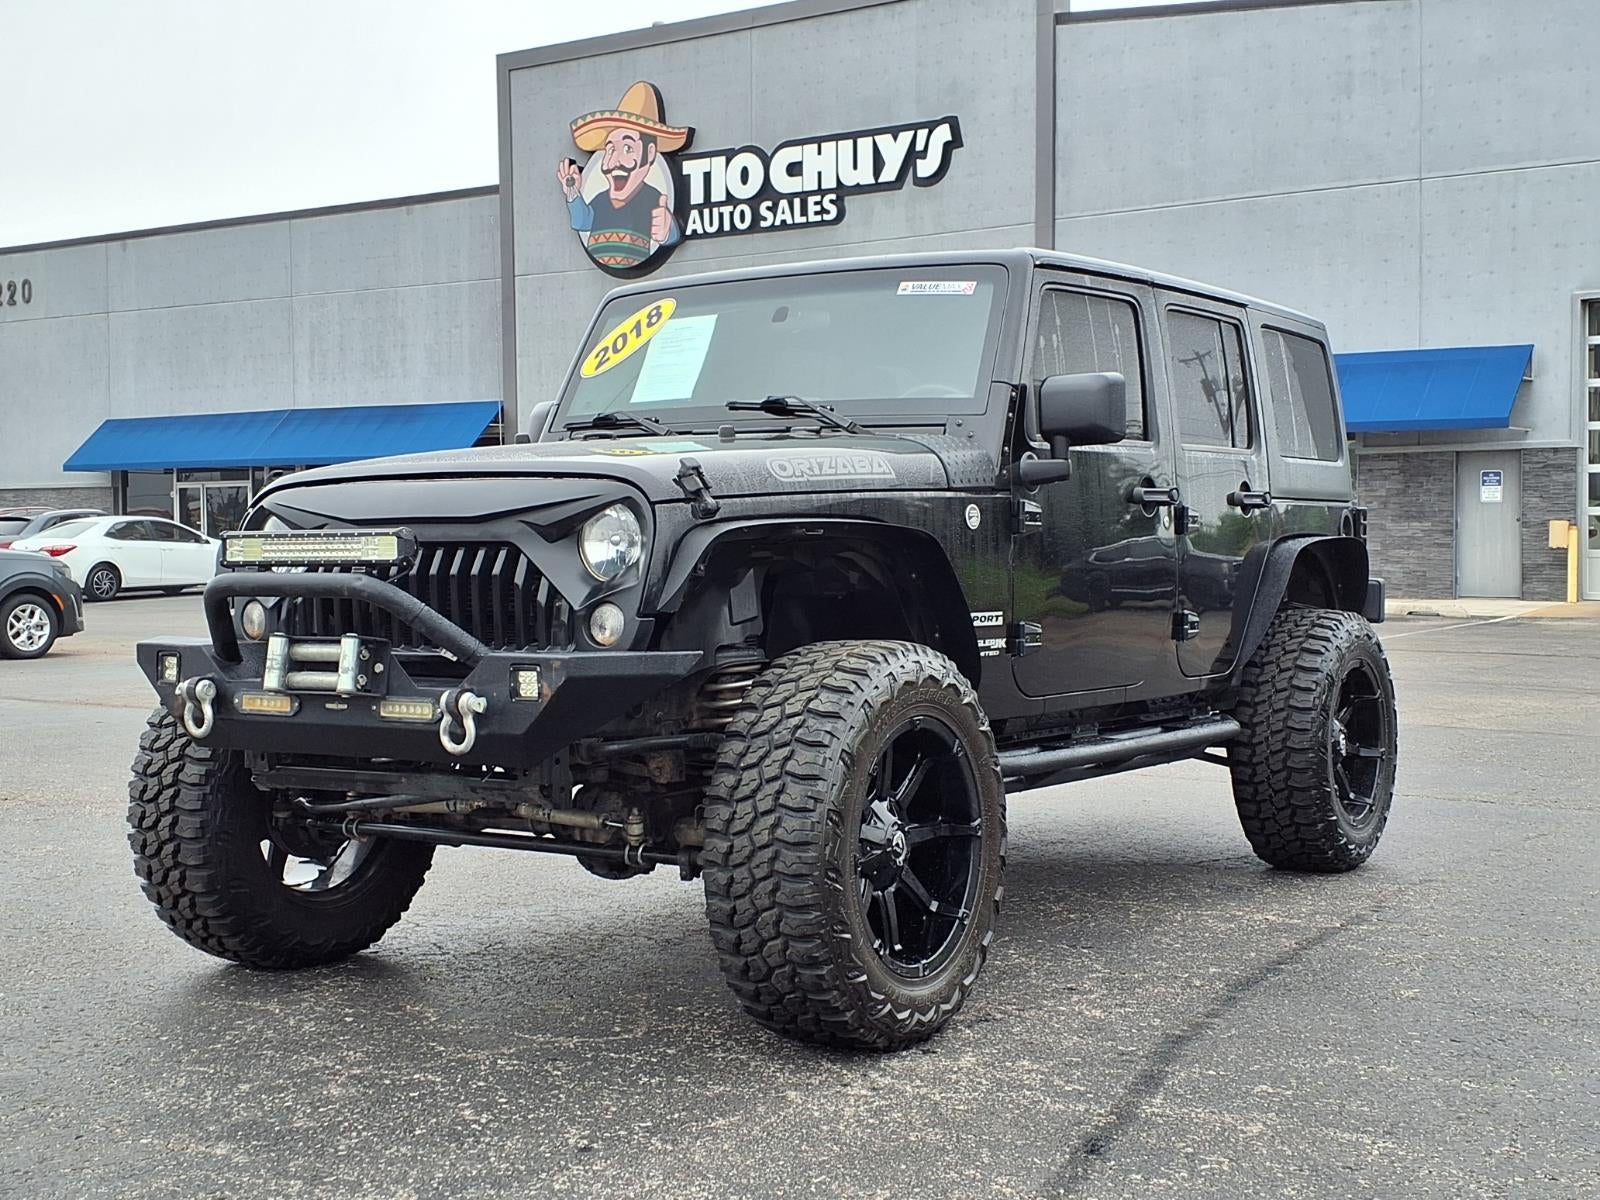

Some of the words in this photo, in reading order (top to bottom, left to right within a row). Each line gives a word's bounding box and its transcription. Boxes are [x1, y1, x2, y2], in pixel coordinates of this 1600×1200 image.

[682, 152, 765, 205] TIO
[769, 123, 953, 194] CHUY'S
[685, 204, 752, 236] AUTO
[759, 193, 838, 228] SALES
[0, 278, 32, 306] 20
[594, 304, 663, 372] 2018
[770, 455, 890, 478] ORIZABA
[972, 614, 1002, 623] PORT
